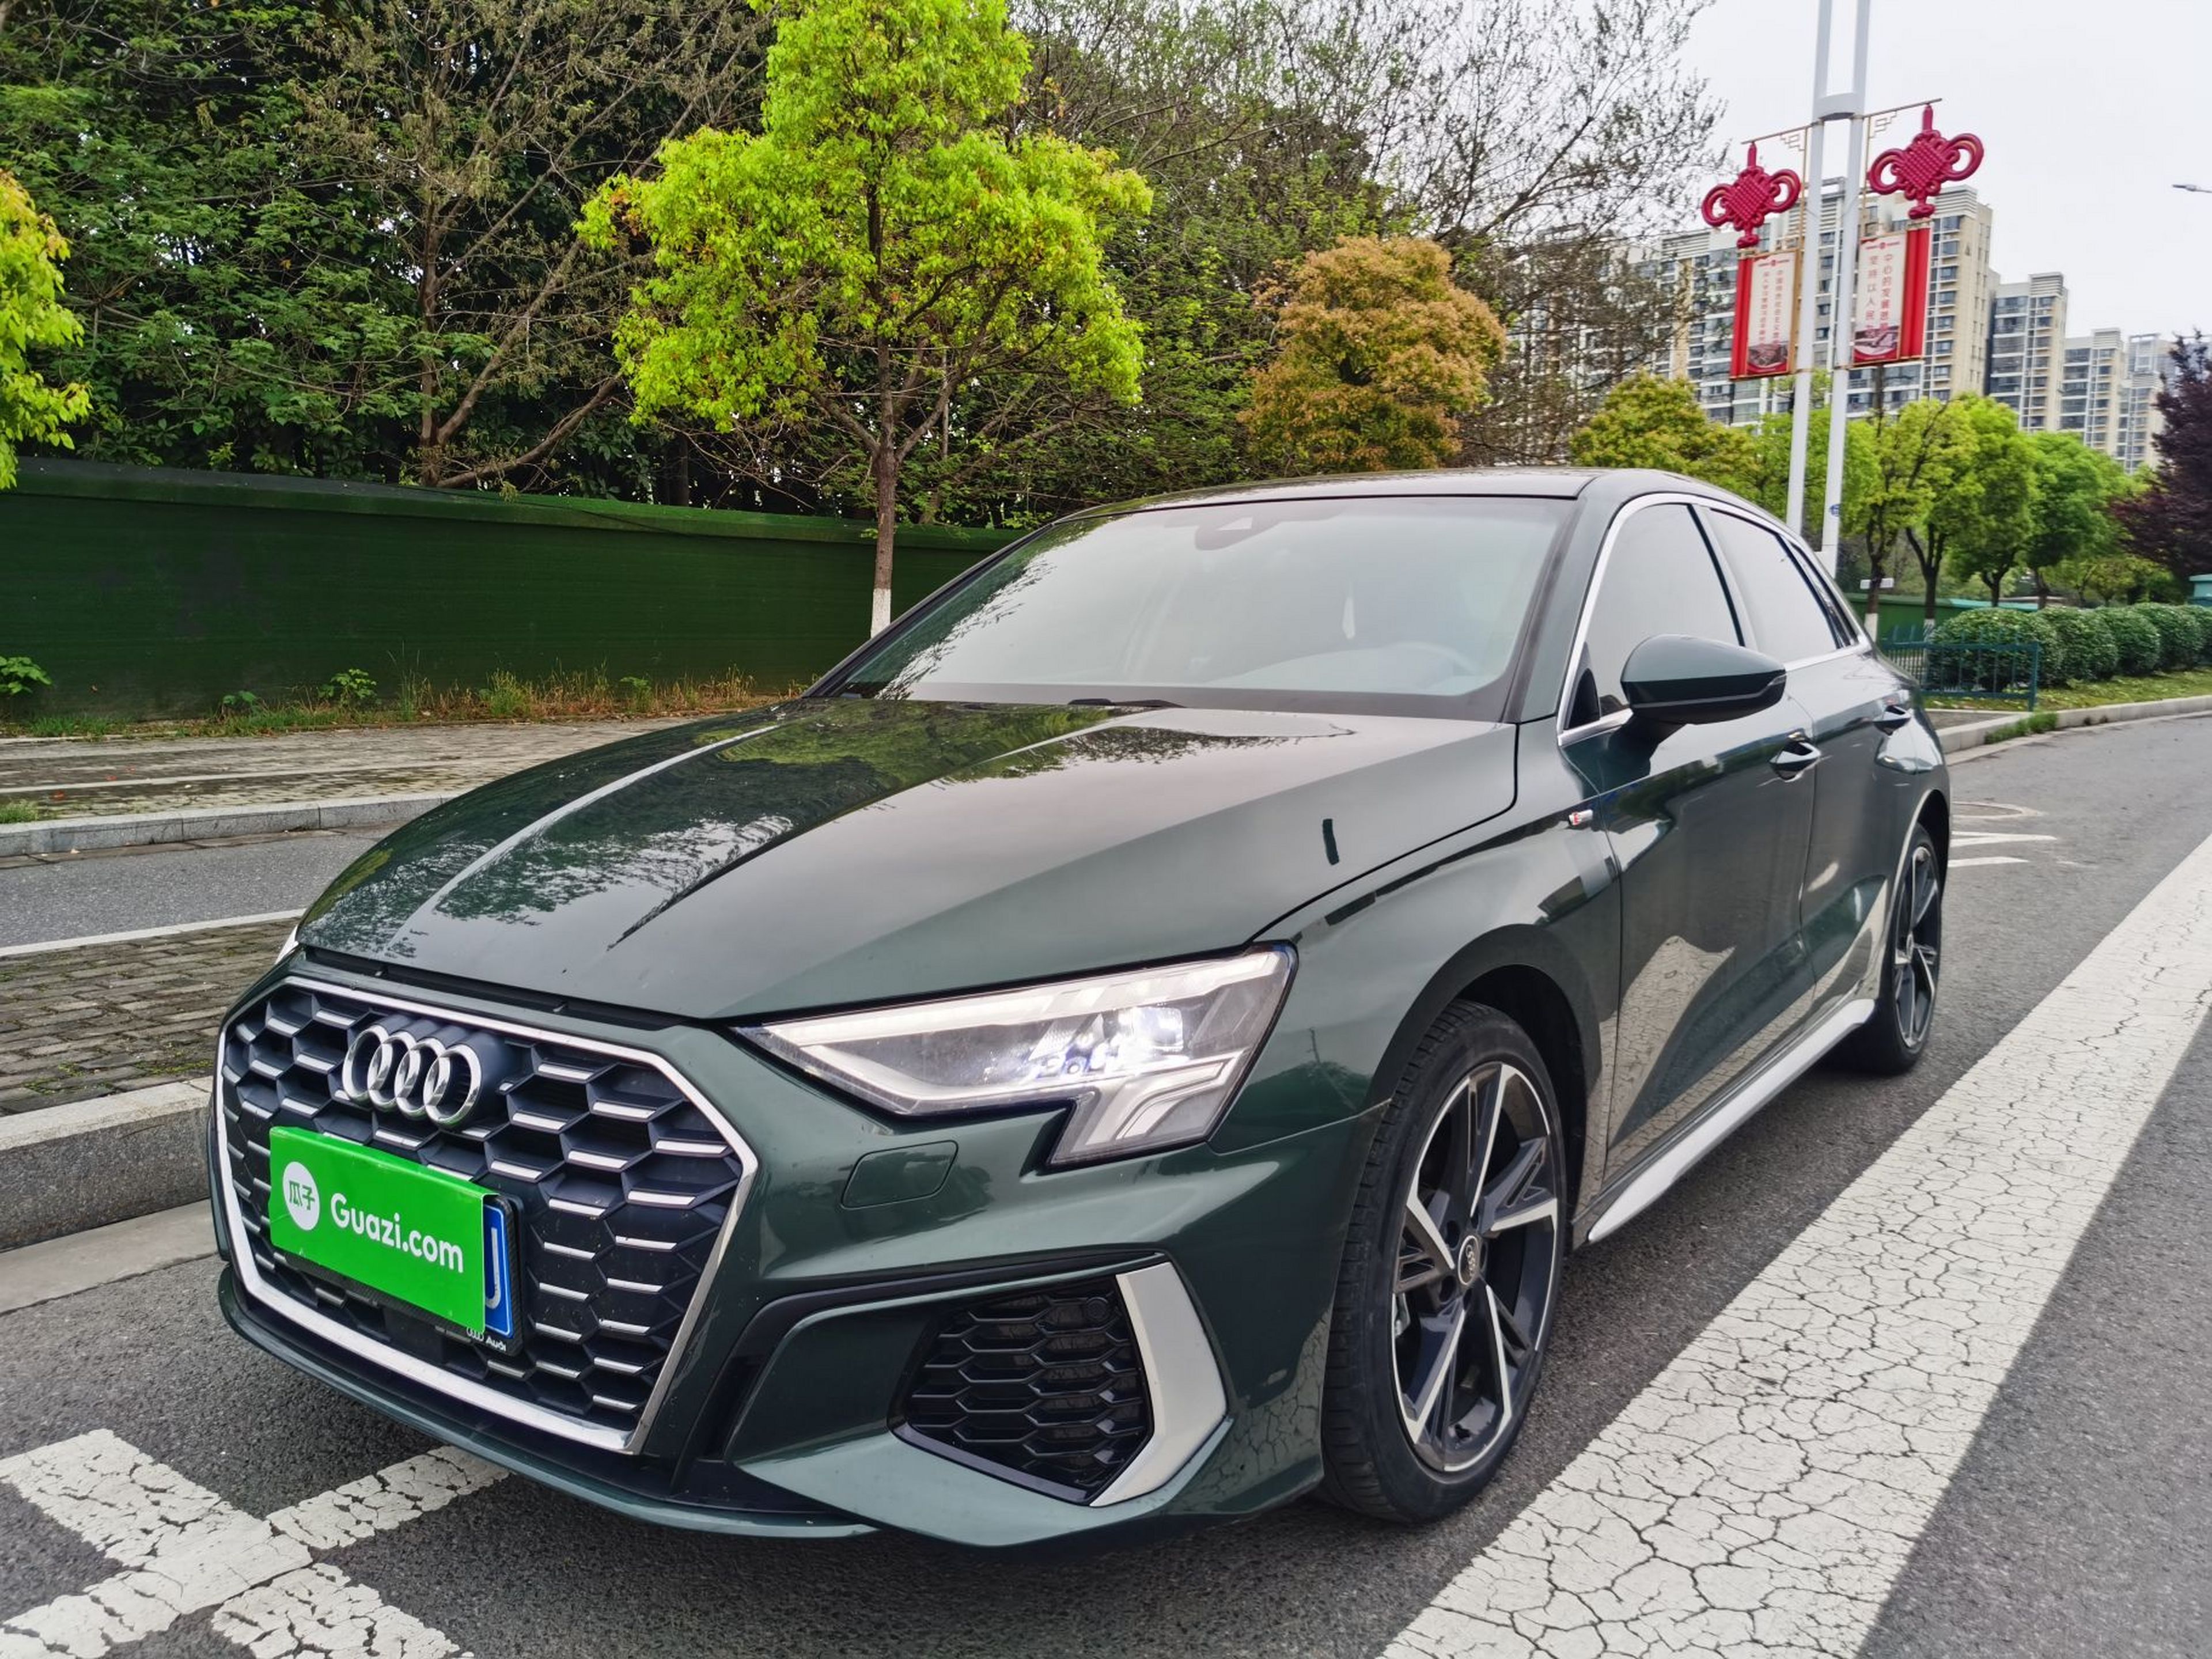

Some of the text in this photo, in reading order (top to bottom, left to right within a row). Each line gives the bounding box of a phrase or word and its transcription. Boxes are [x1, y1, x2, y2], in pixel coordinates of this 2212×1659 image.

[289, 1180, 316, 1211] 瓜子
[331, 1193, 464, 1273] Guazi.com
[486, 1336, 506, 1352] Audi
